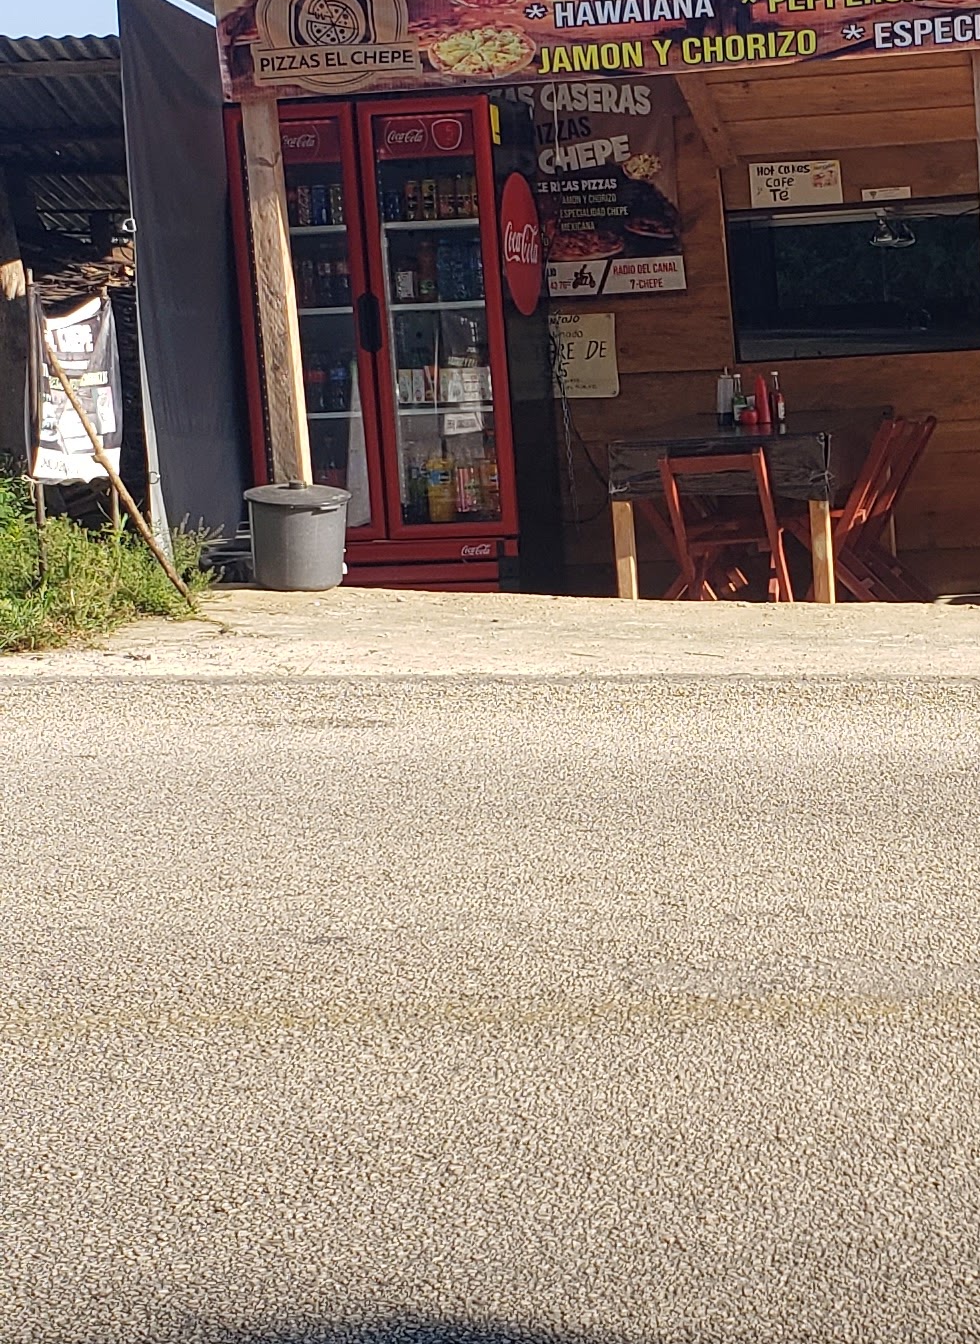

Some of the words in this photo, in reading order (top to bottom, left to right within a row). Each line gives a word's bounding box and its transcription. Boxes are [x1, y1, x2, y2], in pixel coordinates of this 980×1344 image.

[260, 53, 320, 72] PIZZAS
[325, 52, 348, 67] EL
[350, 49, 414, 65] CHEPE
[537, 41, 644, 75] JAMON
[651, 39, 673, 66] Y
[682, 29, 818, 65] CHORIZO
[540, 83, 651, 116] CASERAS
[387, 129, 424, 144] Coca-Cola
[536, 116, 592, 145] IZZAS
[537, 134, 631, 175] CHEPE
[581, 178, 618, 192] PIZZAS
[504, 221, 539, 265] Coca-Cola
[636, 263, 651, 274] DEL
[652, 261, 678, 273] CANAL
[584, 340, 608, 360] DE
